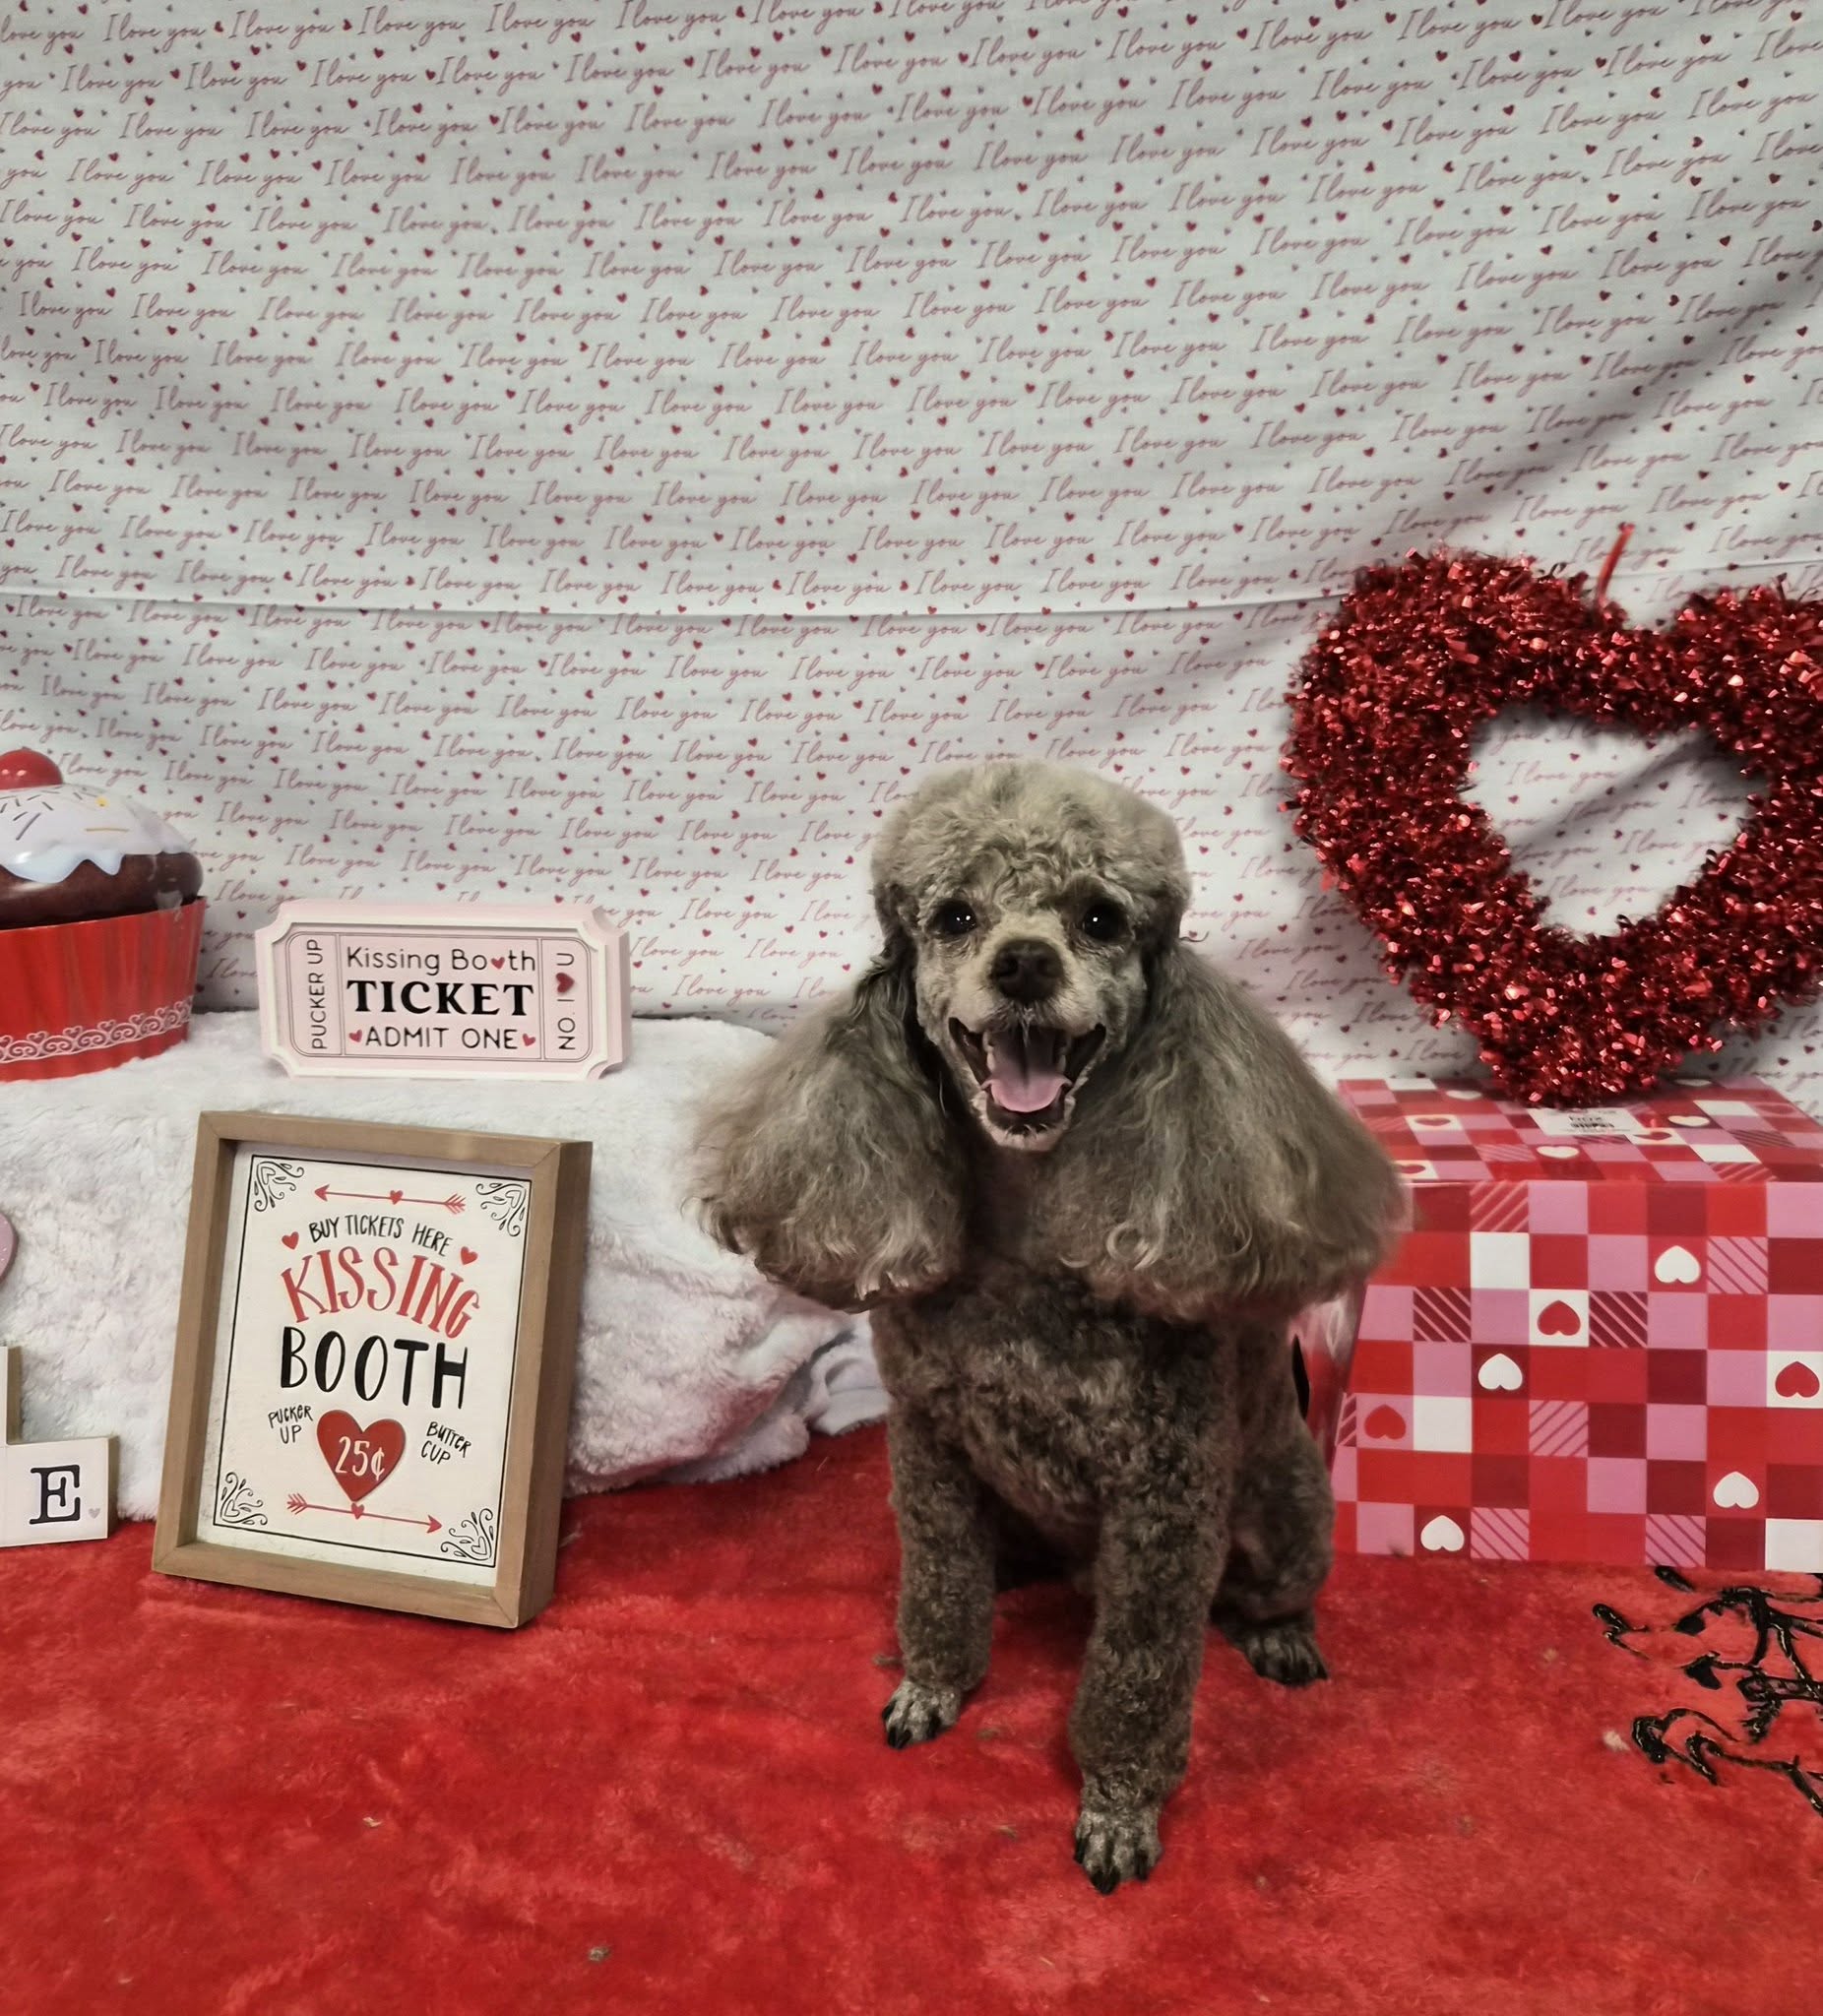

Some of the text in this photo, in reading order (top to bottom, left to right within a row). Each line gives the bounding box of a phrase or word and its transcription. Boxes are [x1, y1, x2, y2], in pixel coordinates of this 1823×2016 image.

[373, 5, 420, 35] love
[417, 20, 467, 47] you
[581, 51, 628, 82] love
[626, 67, 675, 94] you
[986, 35, 1036, 67] love
[1033, 49, 1087, 79] you
[77, 63, 119, 92] love
[118, 79, 163, 104] you
[1329, 67, 1381, 98] love
[1376, 81, 1433, 110] you
[776, 96, 822, 126] love
[820, 112, 870, 140] you
[1707, 87, 1763, 116] love
[1757, 94, 1819, 123] you
[1126, 132, 1175, 163] love
[1172, 146, 1226, 174] you
[341, 158, 385, 186] love
[384, 173, 430, 198] you
[1325, 172, 1376, 202] love
[1372, 184, 1427, 213] you
[1475, 160, 1527, 191] love
[1522, 171, 1582, 199] you
[652, 202, 695, 229] love
[694, 217, 742, 242] you
[88, 245, 133, 272] love
[131, 262, 179, 284] you
[472, 252, 519, 278] love
[516, 266, 564, 290] you
[994, 239, 1041, 268] love
[1038, 252, 1091, 278] you
[1329, 270, 1378, 299] love
[1375, 282, 1431, 309] you
[274, 295, 319, 321] love
[317, 311, 364, 333] you
[733, 342, 780, 368] love
[777, 355, 827, 380] you
[58, 382, 98, 408] love
[98, 398, 138, 419] you
[534, 387, 580, 413] love
[577, 404, 626, 426] you
[1187, 374, 1237, 404] love
[1232, 388, 1288, 413] you
[246, 431, 285, 456] love
[286, 447, 327, 469] you
[1408, 411, 1457, 441] love
[1453, 424, 1507, 451] you
[868, 431, 915, 459] love
[912, 446, 963, 471] you
[667, 480, 713, 506] love
[710, 494, 758, 518] you
[1666, 484, 1717, 512] love
[1713, 494, 1770, 520] you
[874, 524, 919, 550] love
[916, 537, 965, 561] you
[1266, 514, 1313, 541] love
[1309, 528, 1360, 551] you
[71, 554, 114, 579] love
[113, 570, 157, 591] you
[435, 566, 477, 591] love
[475, 581, 522, 602] you
[675, 569, 720, 595] love
[718, 585, 764, 605] you
[1057, 567, 1104, 593] love
[1100, 580, 1150, 602] you
[156, 681, 196, 705] love
[196, 697, 236, 717] you
[394, 691, 436, 715] love
[433, 705, 479, 726] you
[1004, 697, 1048, 722] love
[1045, 709, 1093, 730] you
[566, 736, 608, 760] love
[606, 751, 653, 772] you
[807, 740, 849, 764] love
[848, 753, 894, 774] you
[1181, 732, 1226, 756] love
[1223, 744, 1270, 766] you
[1525, 760, 1567, 784] love
[1569, 772, 1619, 793] you
[229, 801, 269, 823] love
[268, 816, 309, 835] you
[299, 844, 341, 866] love
[338, 857, 379, 878] you
[529, 854, 569, 876] love
[567, 868, 612, 888] you
[694, 898, 736, 919] love
[732, 913, 779, 931] you
[347, 946, 440, 976] Kissing
[556, 953, 575, 967] U
[307, 939, 328, 1049] PUCKER UP
[346, 980, 534, 1017] TICKET
[365, 1026, 519, 1049] ADMIT ONE
[309, 1214, 454, 1257] BUY TICKETS HERE
[281, 1245, 481, 1339] KISSING
[281, 1326, 469, 1410] BOOTH
[280, 1424, 302, 1444] UP
[420, 1440, 451, 1465] CUP
[335, 1436, 386, 1480] 25¢
[29, 1465, 81, 1525] E
